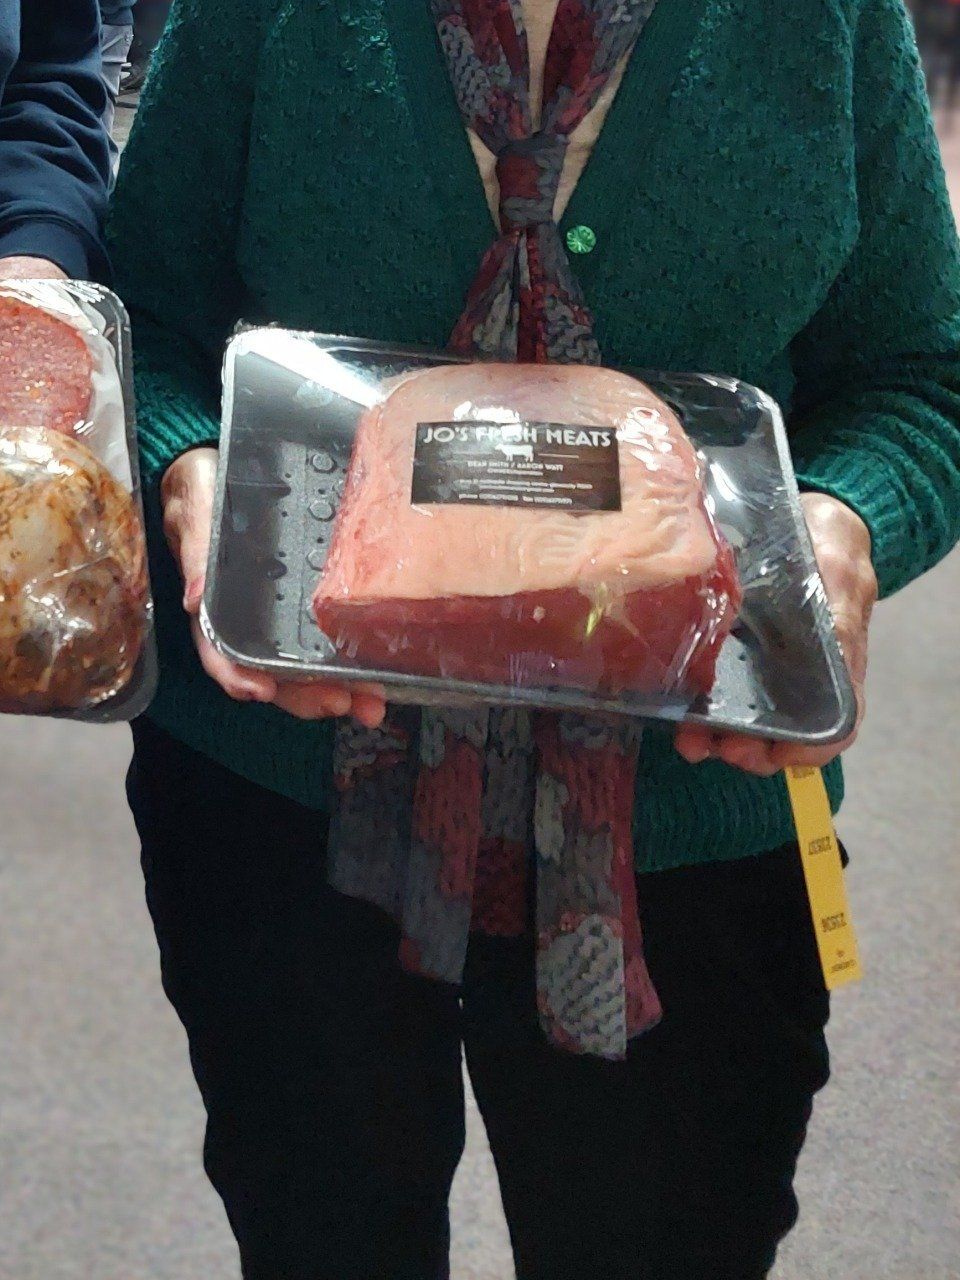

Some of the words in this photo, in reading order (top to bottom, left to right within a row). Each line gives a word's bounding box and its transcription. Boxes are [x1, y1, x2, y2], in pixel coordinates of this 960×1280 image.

[423, 426, 468, 444] JO'S
[475, 424, 537, 444] FRESH
[546, 428, 611, 448] MEATS
